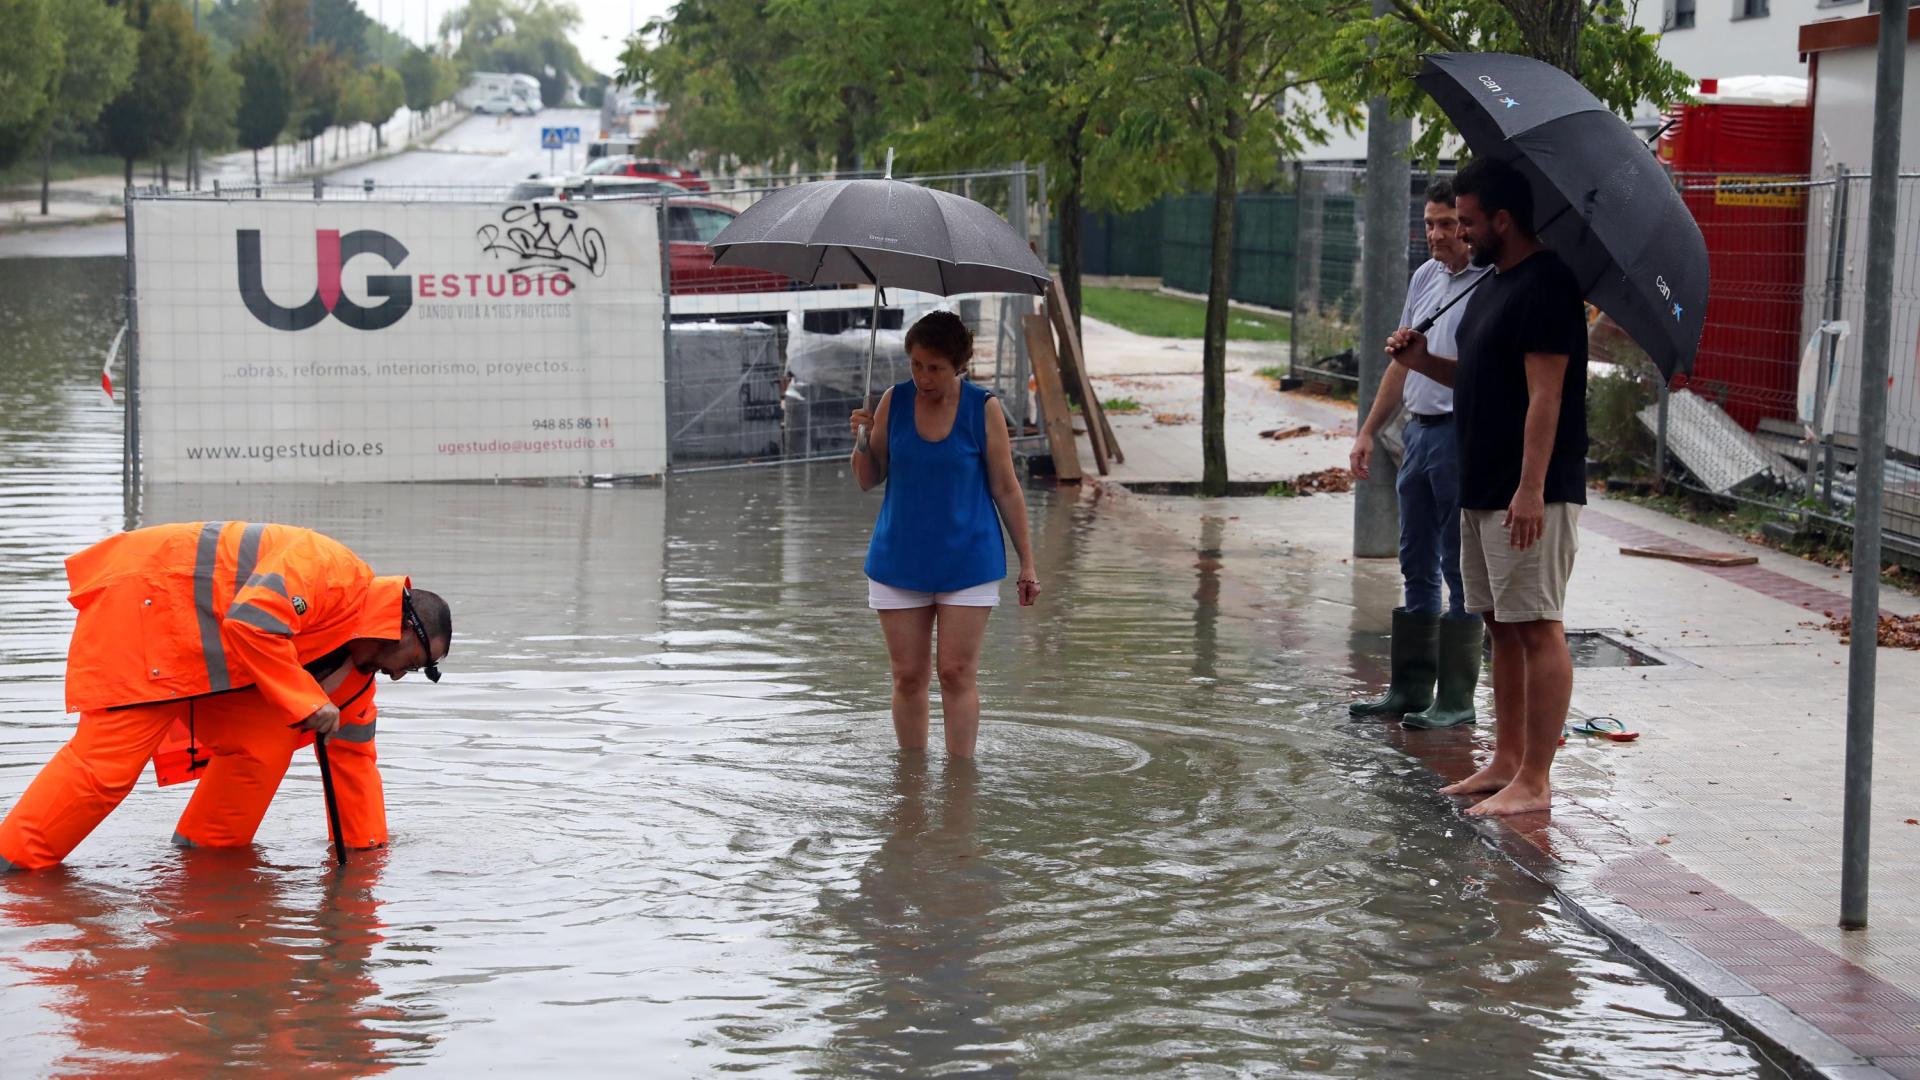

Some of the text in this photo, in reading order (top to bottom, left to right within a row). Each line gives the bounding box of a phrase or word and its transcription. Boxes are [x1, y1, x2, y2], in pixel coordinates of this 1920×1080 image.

[1478, 75, 1502, 92] can
[236, 229, 413, 331] UG
[418, 273, 573, 298] ESTUDIO
[1656, 275, 1670, 300] can
[419, 304, 453, 319] DANDO
[457, 304, 480, 319] VIDA
[484, 304, 491, 318] A
[515, 303, 571, 318] PROYECTOS
[294, 361, 372, 377] reformas,
[376, 360, 480, 376] interiorismo,
[532, 417, 608, 431] 948 85 86 11
[186, 440, 384, 462] www.ugestudio.es
[438, 436, 615, 455] ugestudio@ugestudio.es
